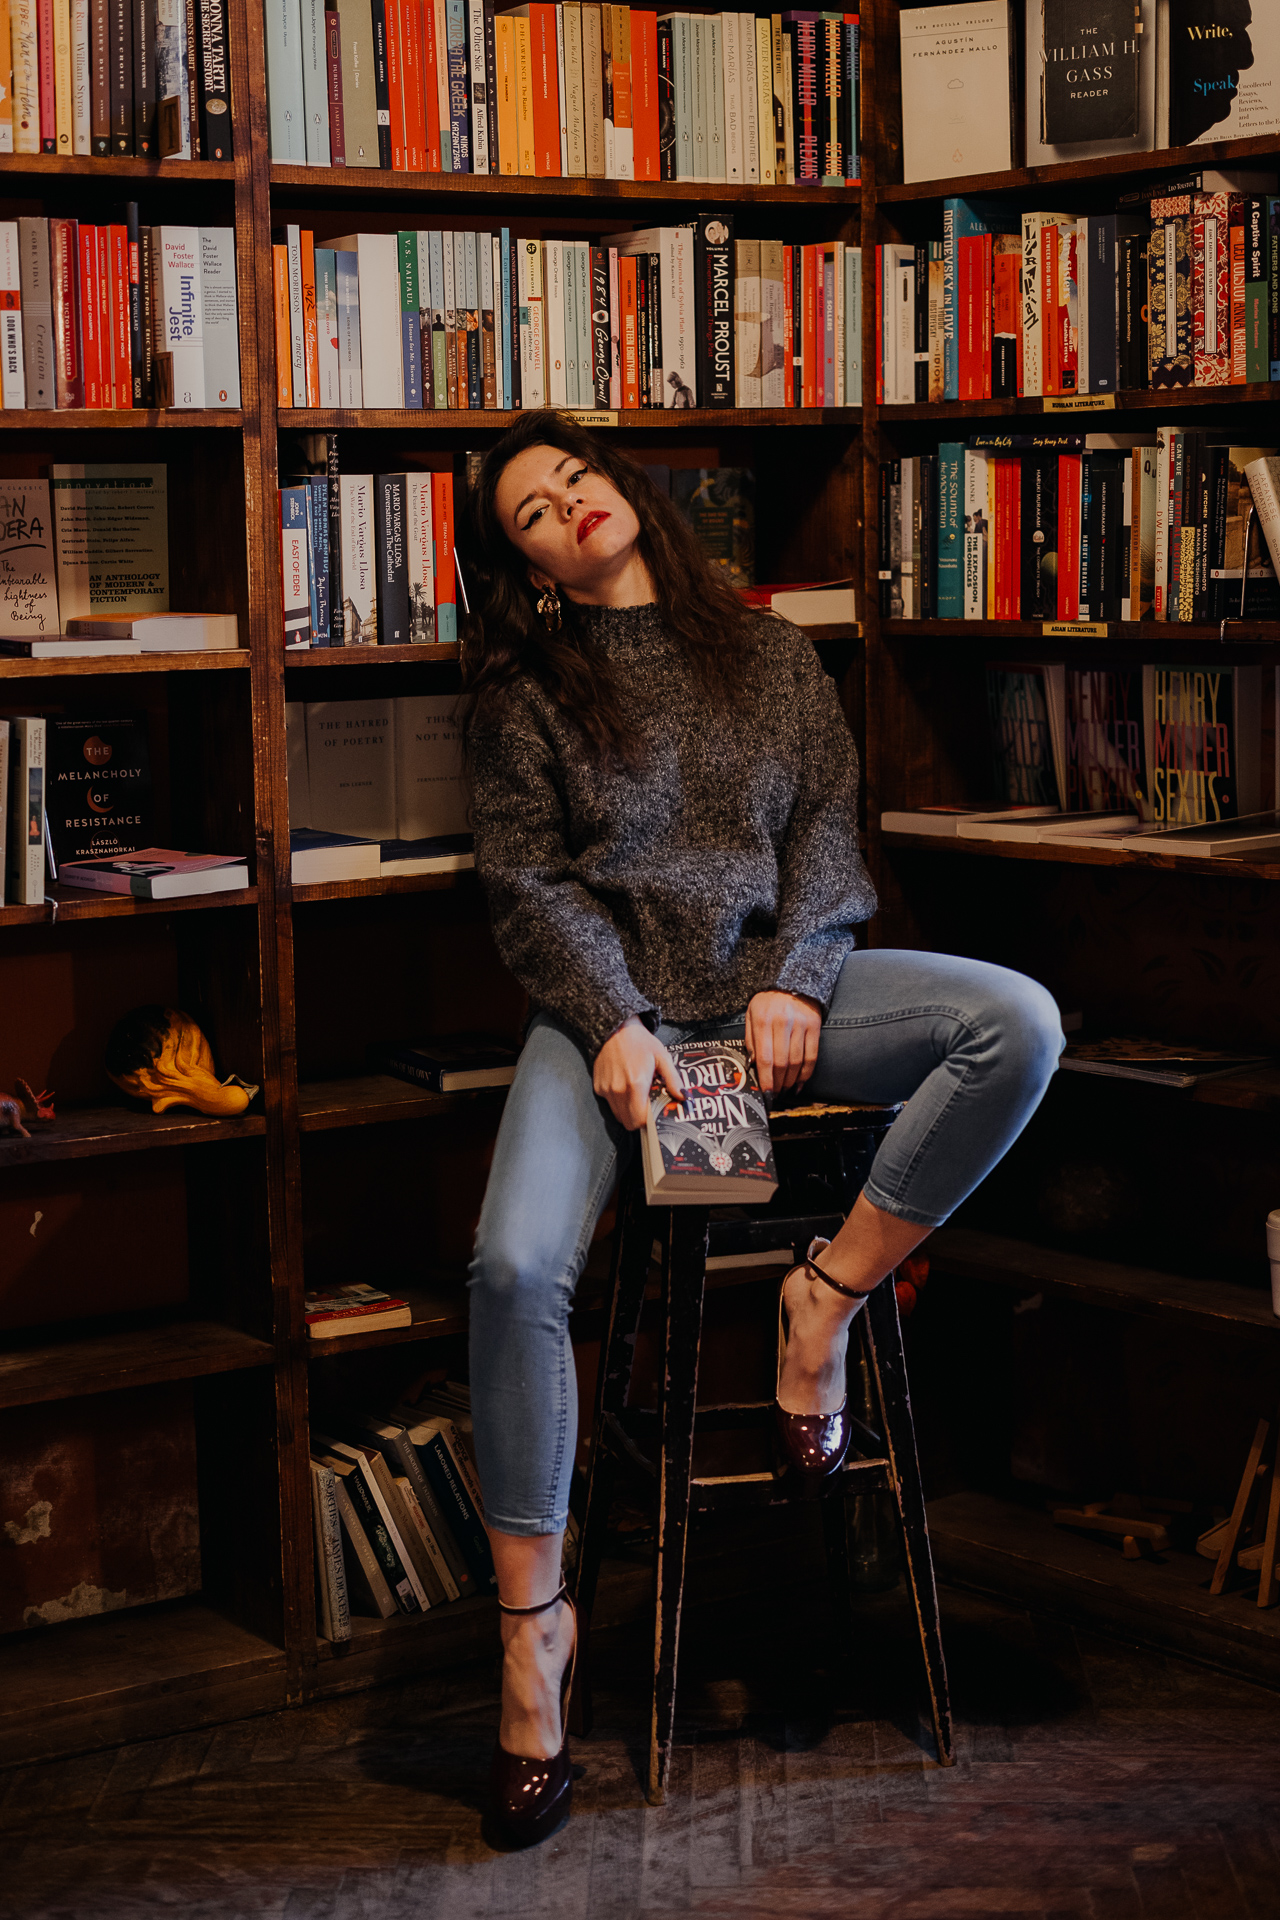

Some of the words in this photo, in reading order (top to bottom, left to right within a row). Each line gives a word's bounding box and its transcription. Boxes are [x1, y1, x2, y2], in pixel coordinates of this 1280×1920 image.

[76, 11, 84, 32] Run
[473, 9, 481, 24] The
[1080, 27, 1098, 35] THE
[202, 13, 212, 51] SECRET
[450, 16, 464, 56] ZORBA
[474, 26, 483, 54] Other
[761, 27, 769, 62] JAVIER
[797, 21, 816, 59] HENRY
[825, 19, 840, 54] HENRY
[846, 24, 858, 49] HENRY
[935, 36, 974, 46] AGUSTÍN
[1187, 24, 1233, 40] Write,
[76, 42, 85, 81] William
[475, 55, 483, 72] Side
[846, 51, 859, 80] MILLER
[913, 47, 965, 58] FERNÁNDEZ
[969, 44, 998, 52] MALLO
[1038, 43, 1115, 63] WILLIAM
[1124, 39, 1140, 54] H.
[204, 54, 214, 93] HISTORY
[213, 46, 226, 93] TARTT
[450, 59, 464, 79] THE
[825, 58, 841, 97] MILLER
[1066, 66, 1113, 83] GASS
[762, 65, 770, 104] MARÍAS
[798, 62, 816, 106] MILLER
[1070, 89, 1109, 99] READER
[75, 85, 86, 118] Styron
[451, 81, 466, 117] GREEK
[452, 121, 461, 169] KAZANTZAKIS
[460, 135, 468, 158] NIKOS
[799, 135, 818, 179] PLEXUS
[826, 142, 842, 176] SEXUS
[847, 155, 860, 179] NEXUS
[1249, 212, 1260, 248] Captive
[944, 209, 953, 291] DOSTOEVSKY
[1251, 251, 1261, 277] Spirit
[593, 268, 607, 307] 1984
[713, 255, 729, 317] MARCEL
[944, 294, 952, 304] IN
[180, 275, 195, 336] Infinite
[708, 309, 713, 317] of
[6, 316, 15, 332] LOOK
[169, 307, 182, 341] Jest
[626, 315, 634, 345] NINETEEN
[706, 319, 714, 340] Things
[944, 308, 953, 339] LOVE
[8, 334, 16, 354] WHO'S
[295, 343, 303, 369] mercy
[595, 328, 609, 364] George
[715, 321, 730, 381] PROUST
[9, 356, 17, 374] BACK
[626, 346, 635, 384] EIGHTY-FOUR
[596, 366, 610, 403] Orwell
[1074, 400, 1105, 408] LITERATURE
[357, 485, 365, 517] Mario
[384, 484, 392, 528] Conversation
[420, 484, 428, 515] Mario
[357, 522, 367, 558] Vargas
[393, 513, 401, 542] VARGAS
[419, 520, 430, 556] Vargas
[291, 539, 299, 559] EAST
[1, 560, 16, 572] The
[293, 562, 299, 572] OF
[359, 562, 368, 590] Llosa
[422, 559, 431, 587] Llosa
[4, 587, 47, 607] Lightness
[25, 599, 36, 614] of
[90, 588, 165, 596] CONTEMPORARY
[11, 611, 46, 631] Being
[1065, 671, 1133, 724] HENRY
[1155, 670, 1221, 727] HENRY
[319, 722, 340, 730] THE
[346, 719, 389, 729] HATRED
[86, 747, 109, 756] THE
[343, 736, 385, 746] POETRY
[1065, 720, 1140, 773] MILLER
[1155, 720, 1230, 777] MILLER
[58, 768, 142, 781] MELANCHOLY
[94, 794, 109, 803] OF
[1154, 767, 1221, 823] SEXUS
[66, 815, 141, 828] RESISTANCE
[76, 846, 135, 856] KRASZNAHORKAI
[92, 838, 119, 846] LÁSZLÓ
[666, 1041, 721, 1051] MORGENS
[678, 1055, 746, 1095] CIRC
[675, 1094, 751, 1128] NIGHT
[698, 1121, 727, 1138] The
[433, 1443, 453, 1479] LABORED
[448, 1479, 470, 1521] RELATIONS
[326, 1479, 338, 1526] SORTIES
[332, 1538, 344, 1572] JAMES
[335, 1573, 349, 1615] DICKEY
